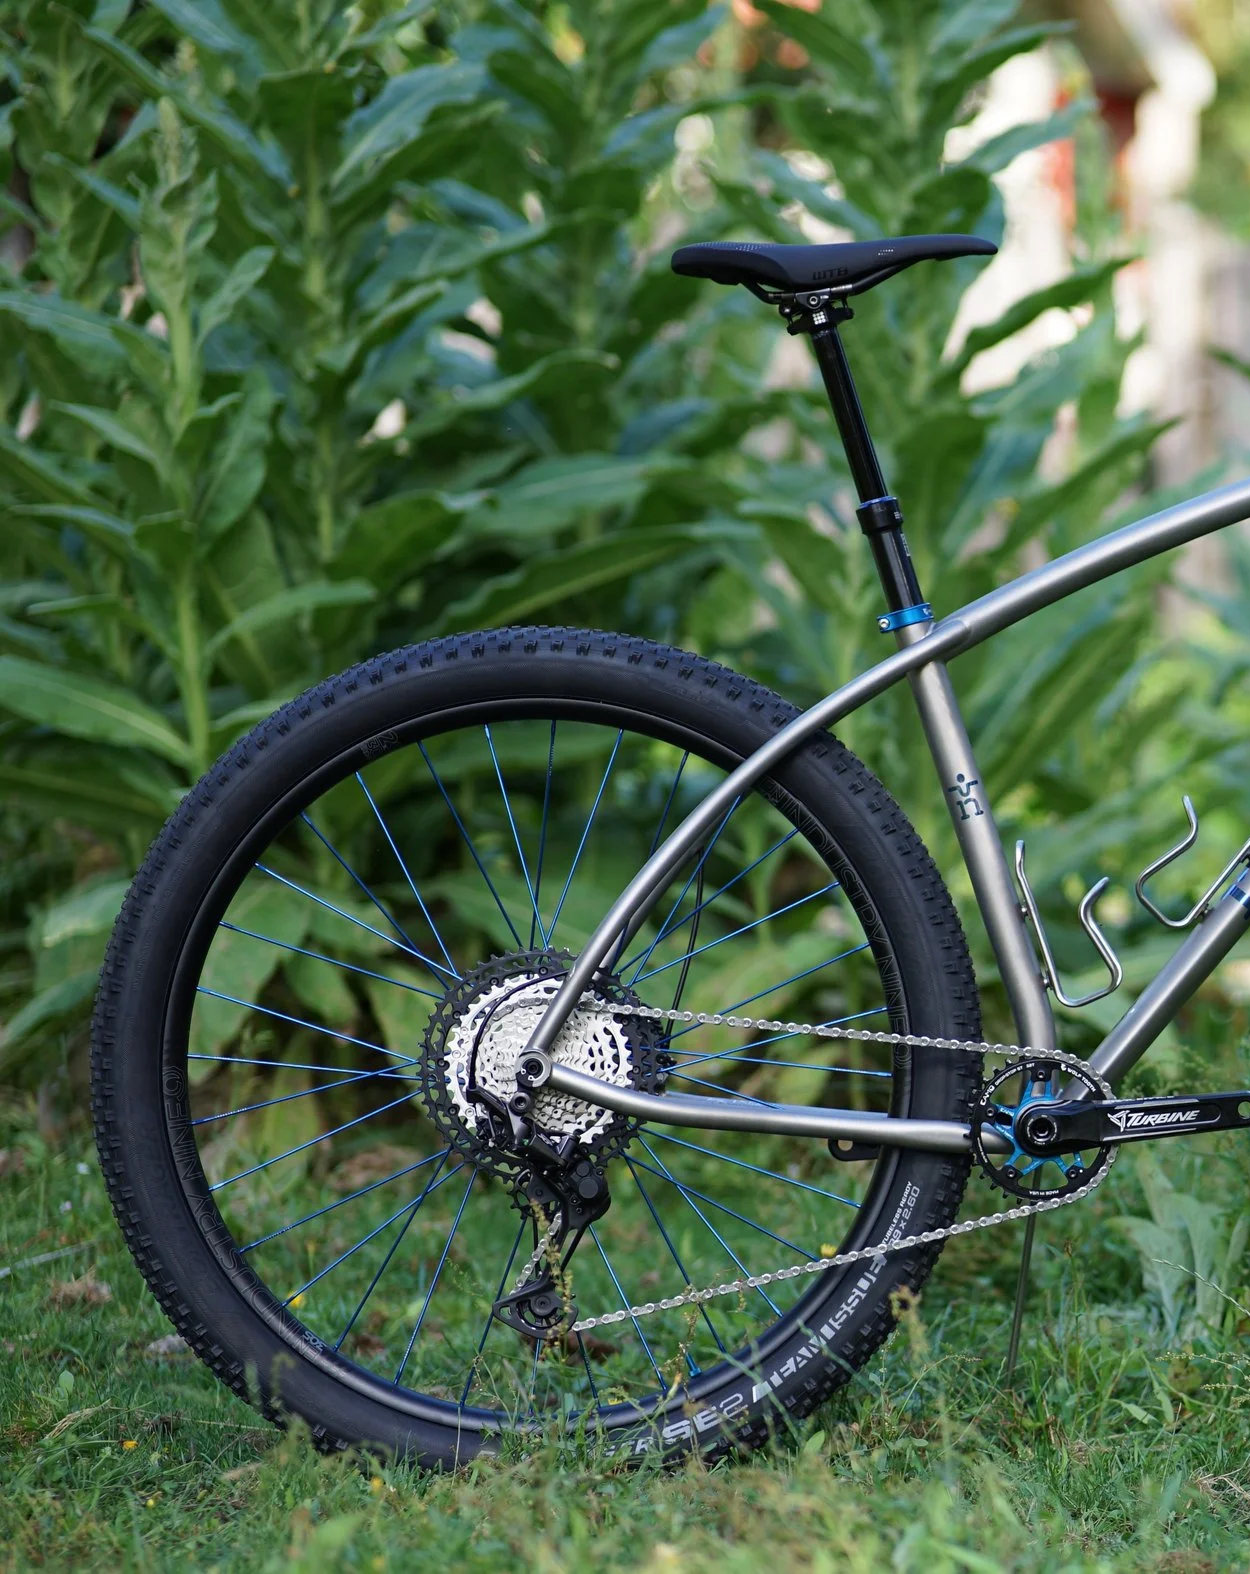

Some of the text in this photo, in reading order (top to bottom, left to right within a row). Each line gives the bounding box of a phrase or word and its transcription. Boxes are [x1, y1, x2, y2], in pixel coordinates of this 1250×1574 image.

[812, 267, 849, 281] WTB
[1079, 1075, 1097, 1093] TOOTH
[1127, 1110, 1201, 1126] TURBINE
[900, 1187, 921, 1222] 2.60
